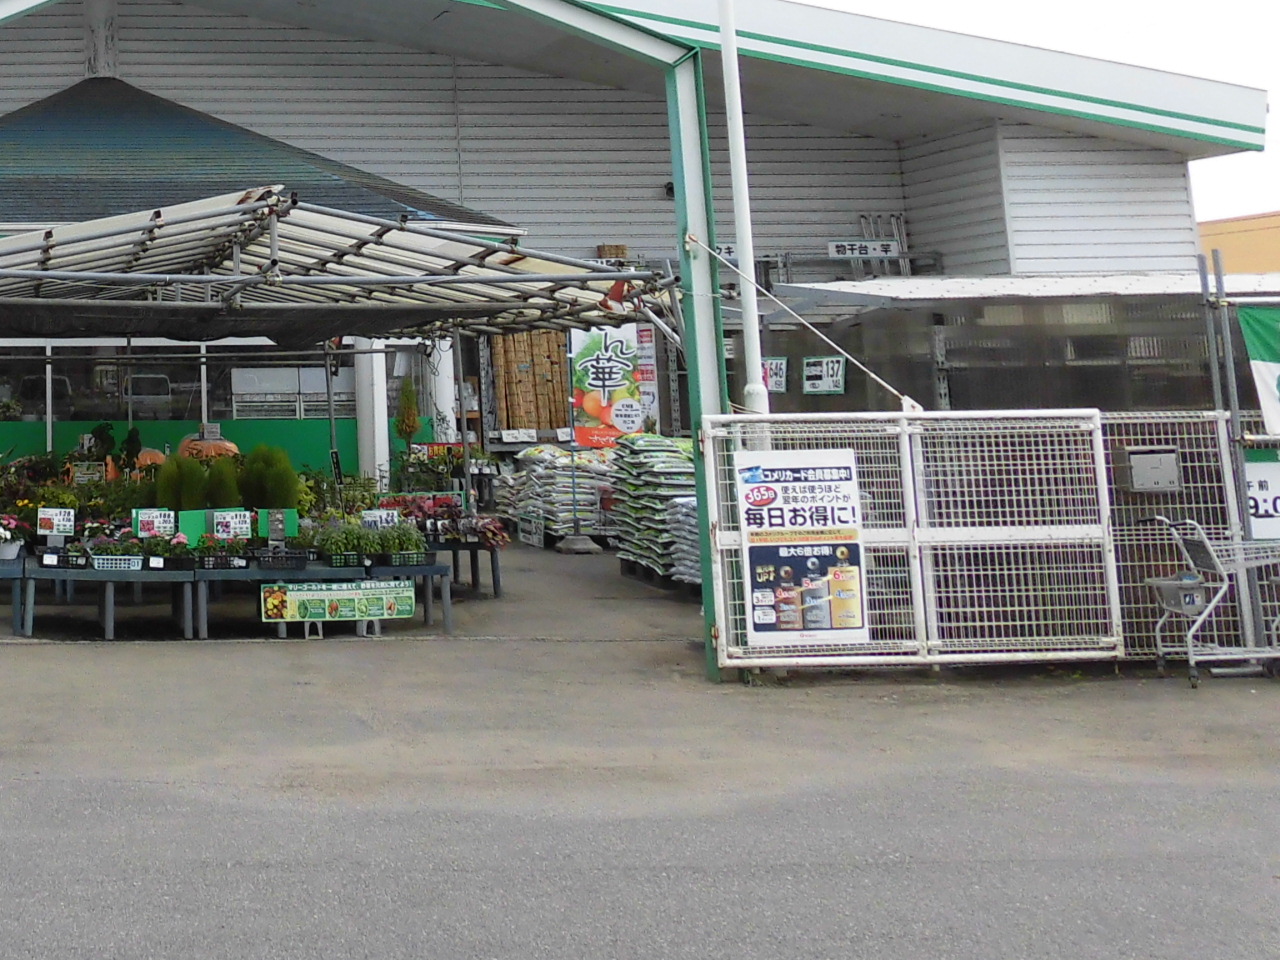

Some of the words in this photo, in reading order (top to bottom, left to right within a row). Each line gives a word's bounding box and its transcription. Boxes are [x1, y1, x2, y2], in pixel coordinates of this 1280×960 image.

[825, 359, 841, 378] 137
[762, 469, 851, 482] コメリカード会員募集中!
[781, 485, 841, 494] 使えば使うほど
[782, 494, 851, 505] 翌年のポイントが
[744, 506, 857, 528] 毎日お得に!
